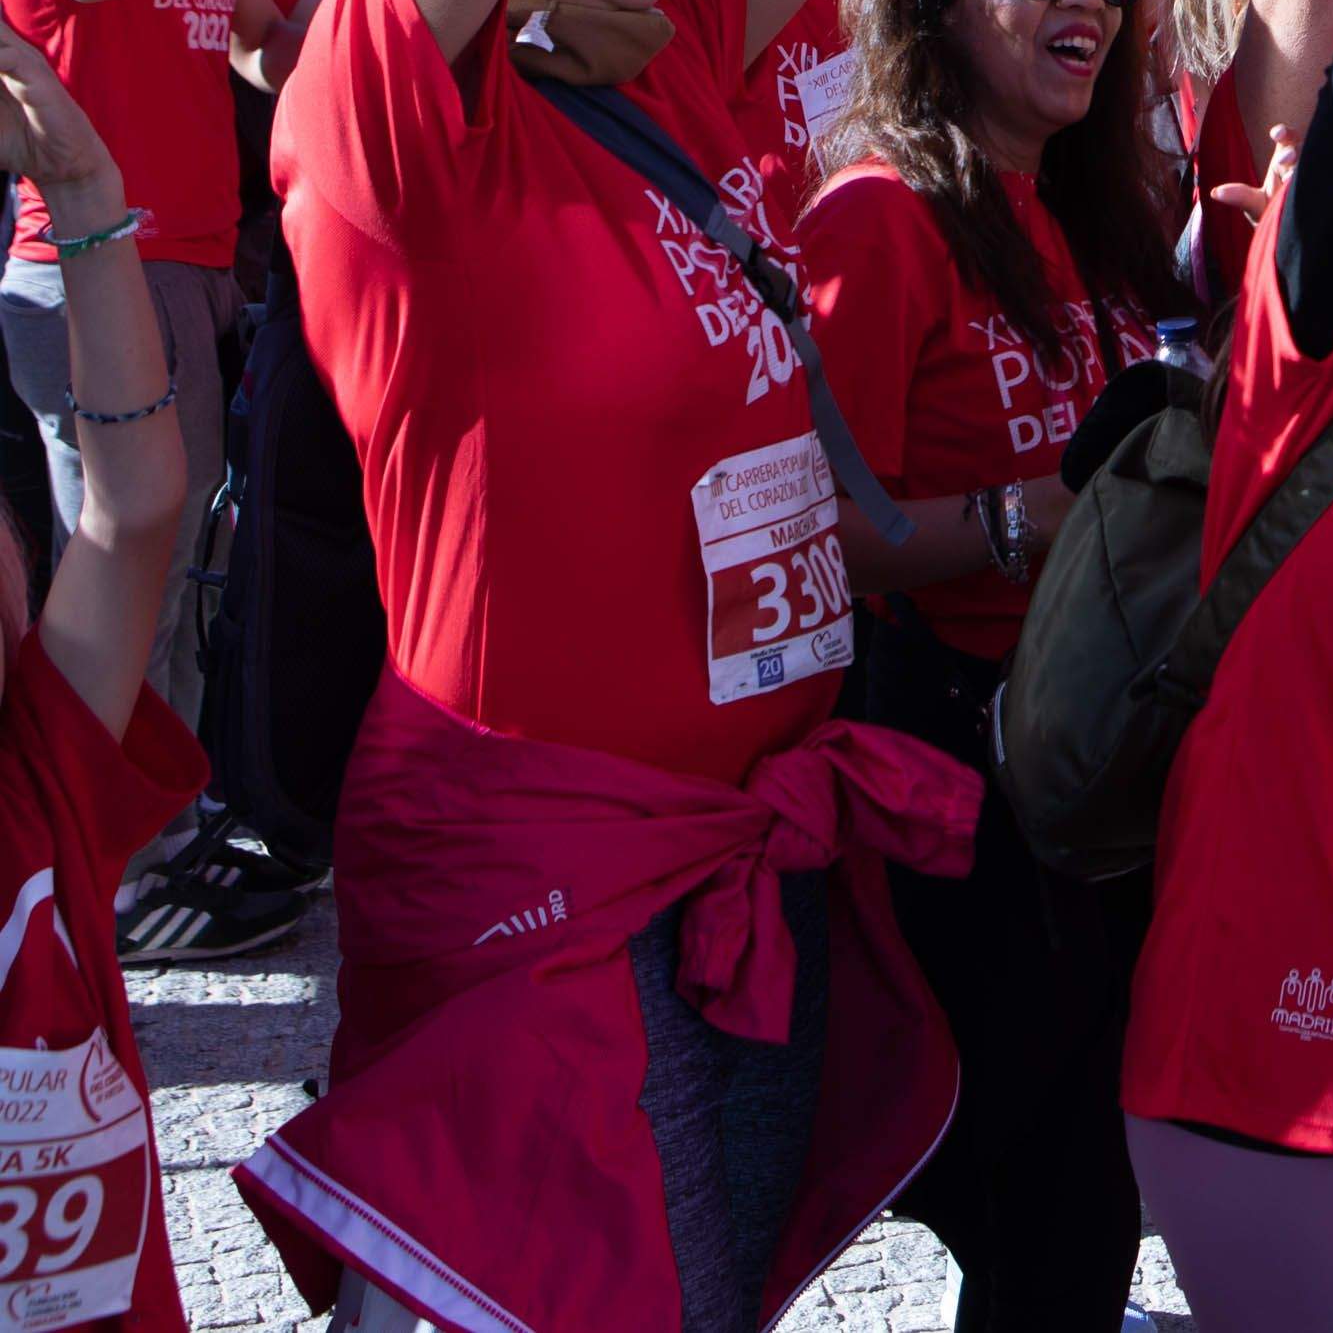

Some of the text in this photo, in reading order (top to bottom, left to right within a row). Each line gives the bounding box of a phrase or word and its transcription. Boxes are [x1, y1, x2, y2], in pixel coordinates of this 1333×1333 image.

[183, 11, 230, 51] 2022
[725, 461, 780, 493] CARRERA
[719, 498, 747, 521] DEL
[748, 481, 799, 511] CORAZÓN
[759, 657, 781, 678] 20
[0, 1068, 68, 1094] PULAR
[35, 1143, 75, 1170] 5K
